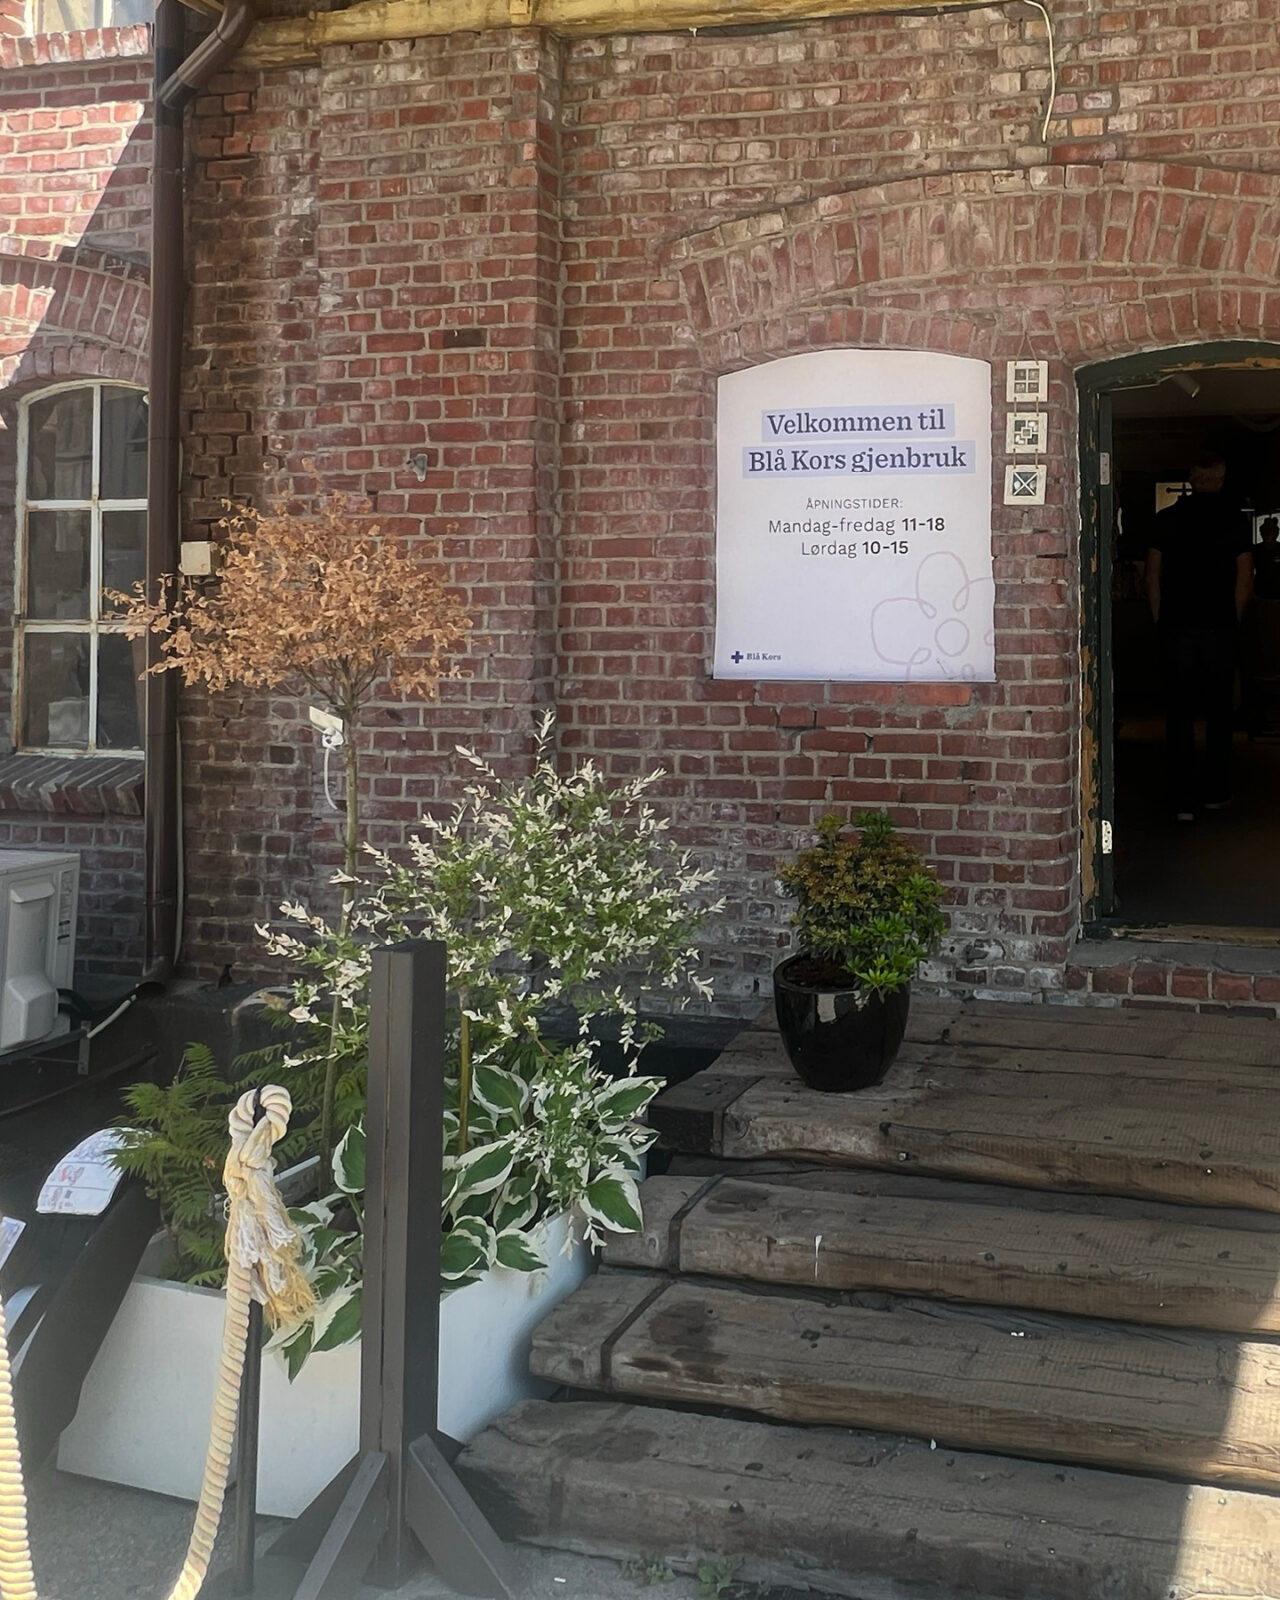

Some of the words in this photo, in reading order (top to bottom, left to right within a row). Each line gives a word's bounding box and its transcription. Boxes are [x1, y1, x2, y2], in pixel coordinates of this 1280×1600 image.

[767, 412, 912, 435] Velkommen
[918, 409, 946, 430] til
[749, 449, 787, 472] Blå
[791, 450, 846, 471] Kors
[851, 446, 967, 473] gjenbruk
[806, 497, 903, 510] ÅPNINGSTIDER:
[769, 517, 896, 536] Mandag-fredag
[901, 518, 945, 532] 11-18
[801, 541, 857, 558] Lørdag
[862, 541, 909, 555] 10-15
[762, 653, 781, 661] Kors
